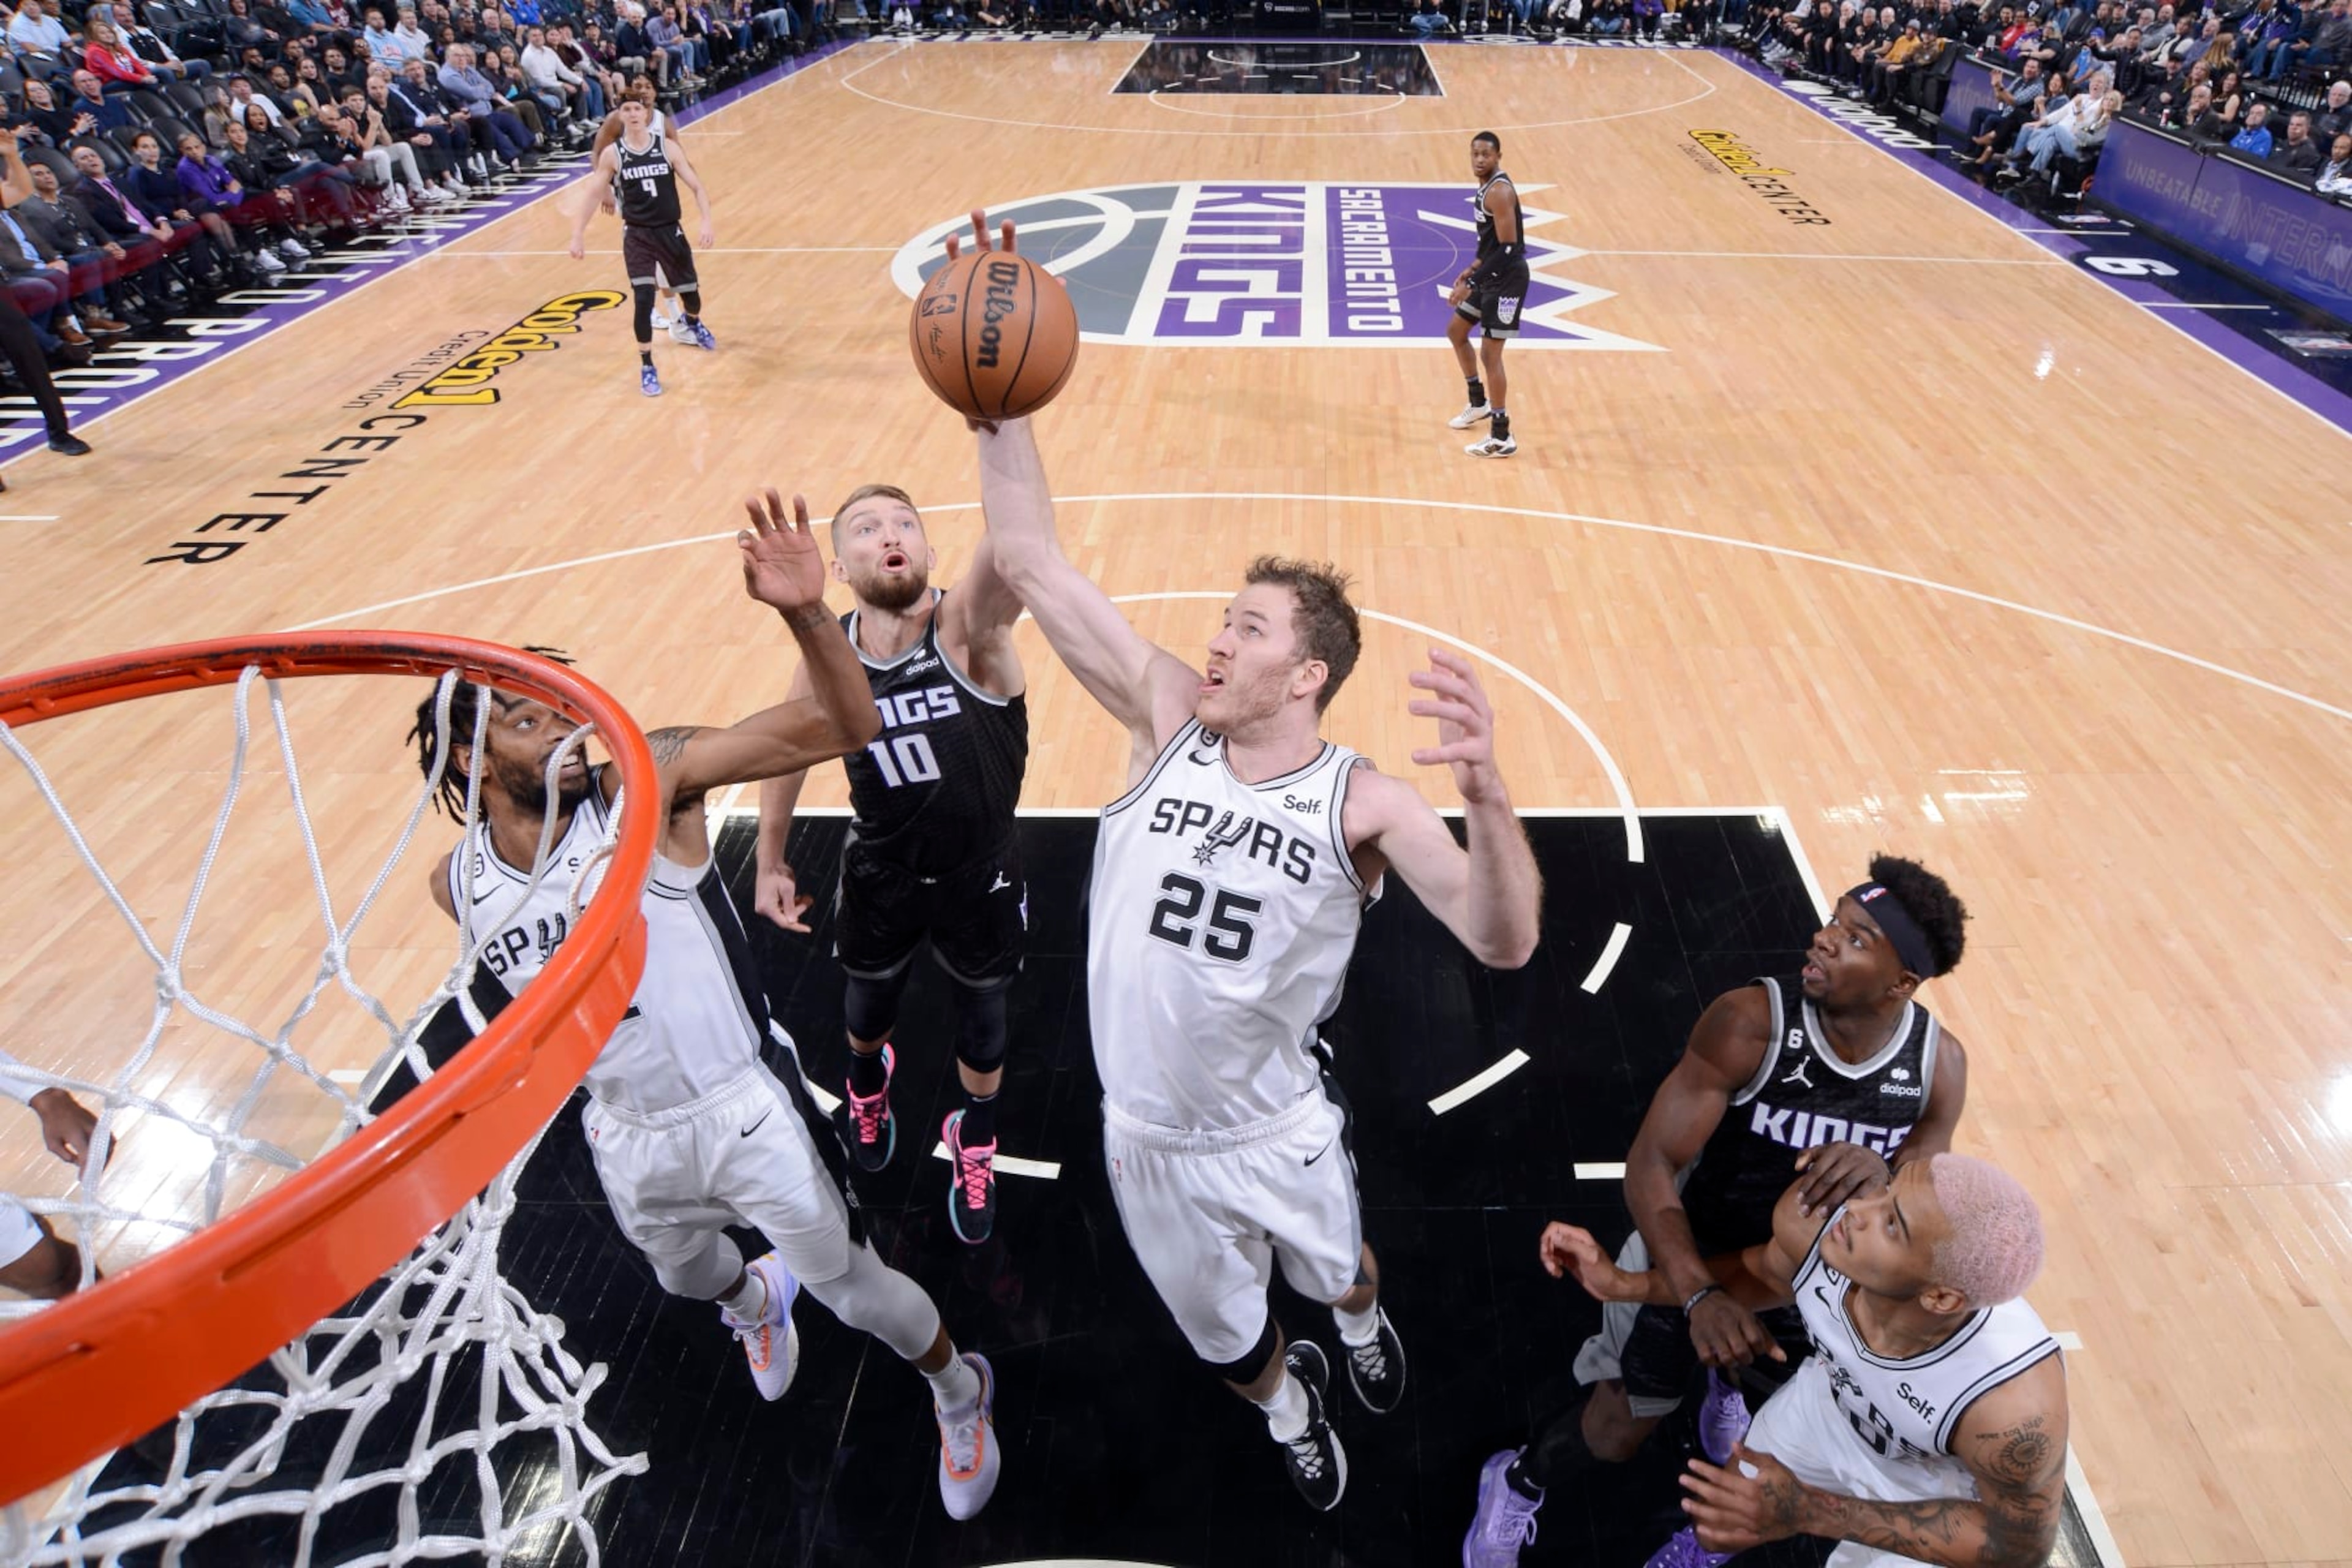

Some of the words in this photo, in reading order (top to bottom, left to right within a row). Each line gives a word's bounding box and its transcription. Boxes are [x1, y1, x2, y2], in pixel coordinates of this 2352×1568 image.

[1809, 96, 1953, 148] dialpad
[622, 164, 669, 181] KINGS
[641, 179, 658, 197] 9
[1741, 176, 1832, 225] CENTER
[2125, 158, 2223, 219] UNBEATABLE
[2225, 190, 2352, 293] INTERN
[1153, 186, 1305, 337] KINGS
[1340, 189, 1403, 331] SACRAMENTO
[2084, 256, 2179, 276] 6
[977, 261, 1020, 368] Wilson
[411, 330, 489, 369] Credit
[342, 369, 431, 409] Union
[144, 415, 427, 565] CENTER
[906, 656, 940, 676] dalpad
[874, 685, 962, 728] NGS
[869, 733, 941, 788] 10
[1283, 795, 1322, 815] Self.
[1150, 798, 1316, 884] SPURS
[1147, 869, 1264, 964] 25
[484, 911, 567, 978] SPU
[1788, 1028, 1803, 1049] 6
[1880, 1082, 1921, 1097] dialpad
[1896, 1382, 1937, 1425] Self.
